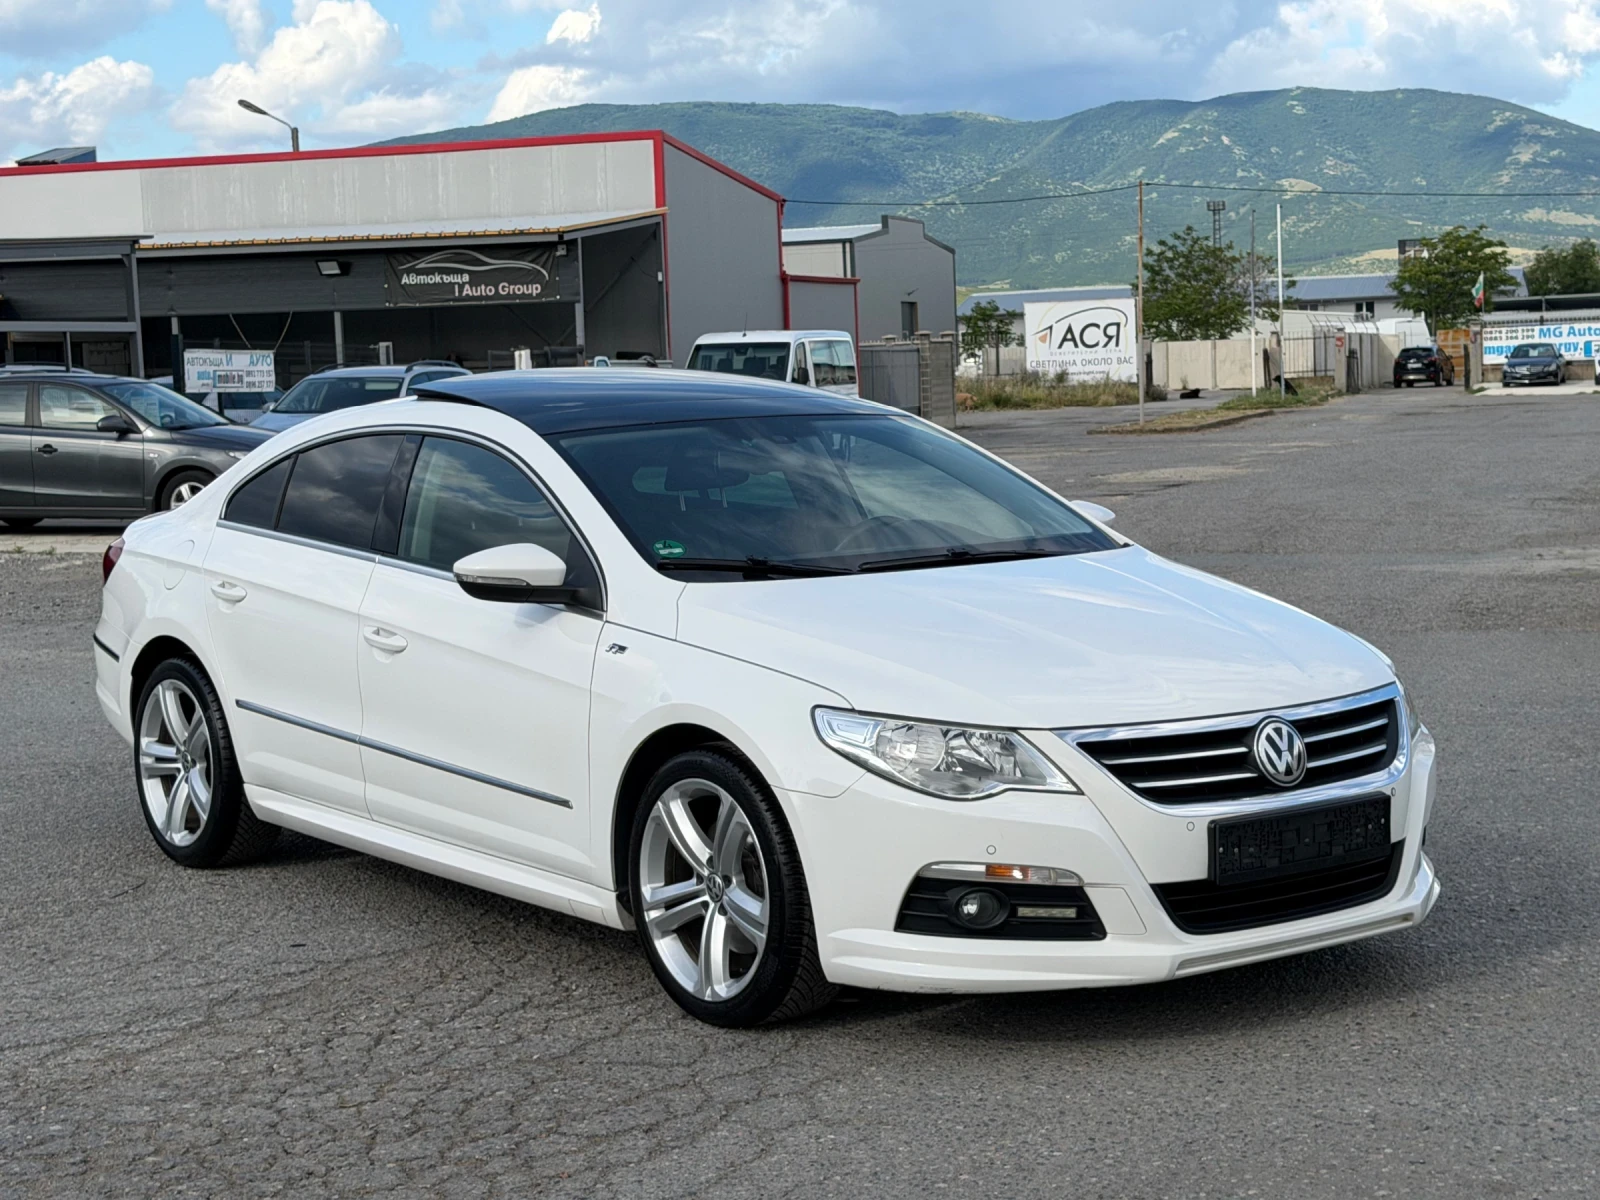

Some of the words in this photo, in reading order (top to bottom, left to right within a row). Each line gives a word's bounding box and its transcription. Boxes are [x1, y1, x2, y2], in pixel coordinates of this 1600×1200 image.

[401, 272, 470, 286] Автокъща
[462, 283, 495, 297] Auto
[498, 281, 542, 297] Group
[1057, 321, 1121, 349] АСЯ
[1538, 326, 1563, 339] MG
[1566, 325, 1600, 337] Auto
[186, 356, 225, 367] АВТОКЪЩА
[248, 353, 273, 367] АУТО
[1029, 359, 1078, 370] СВЕТЛИНА
[1080, 357, 1113, 367] ОКОЛО
[1116, 356, 1134, 365] ВАС
